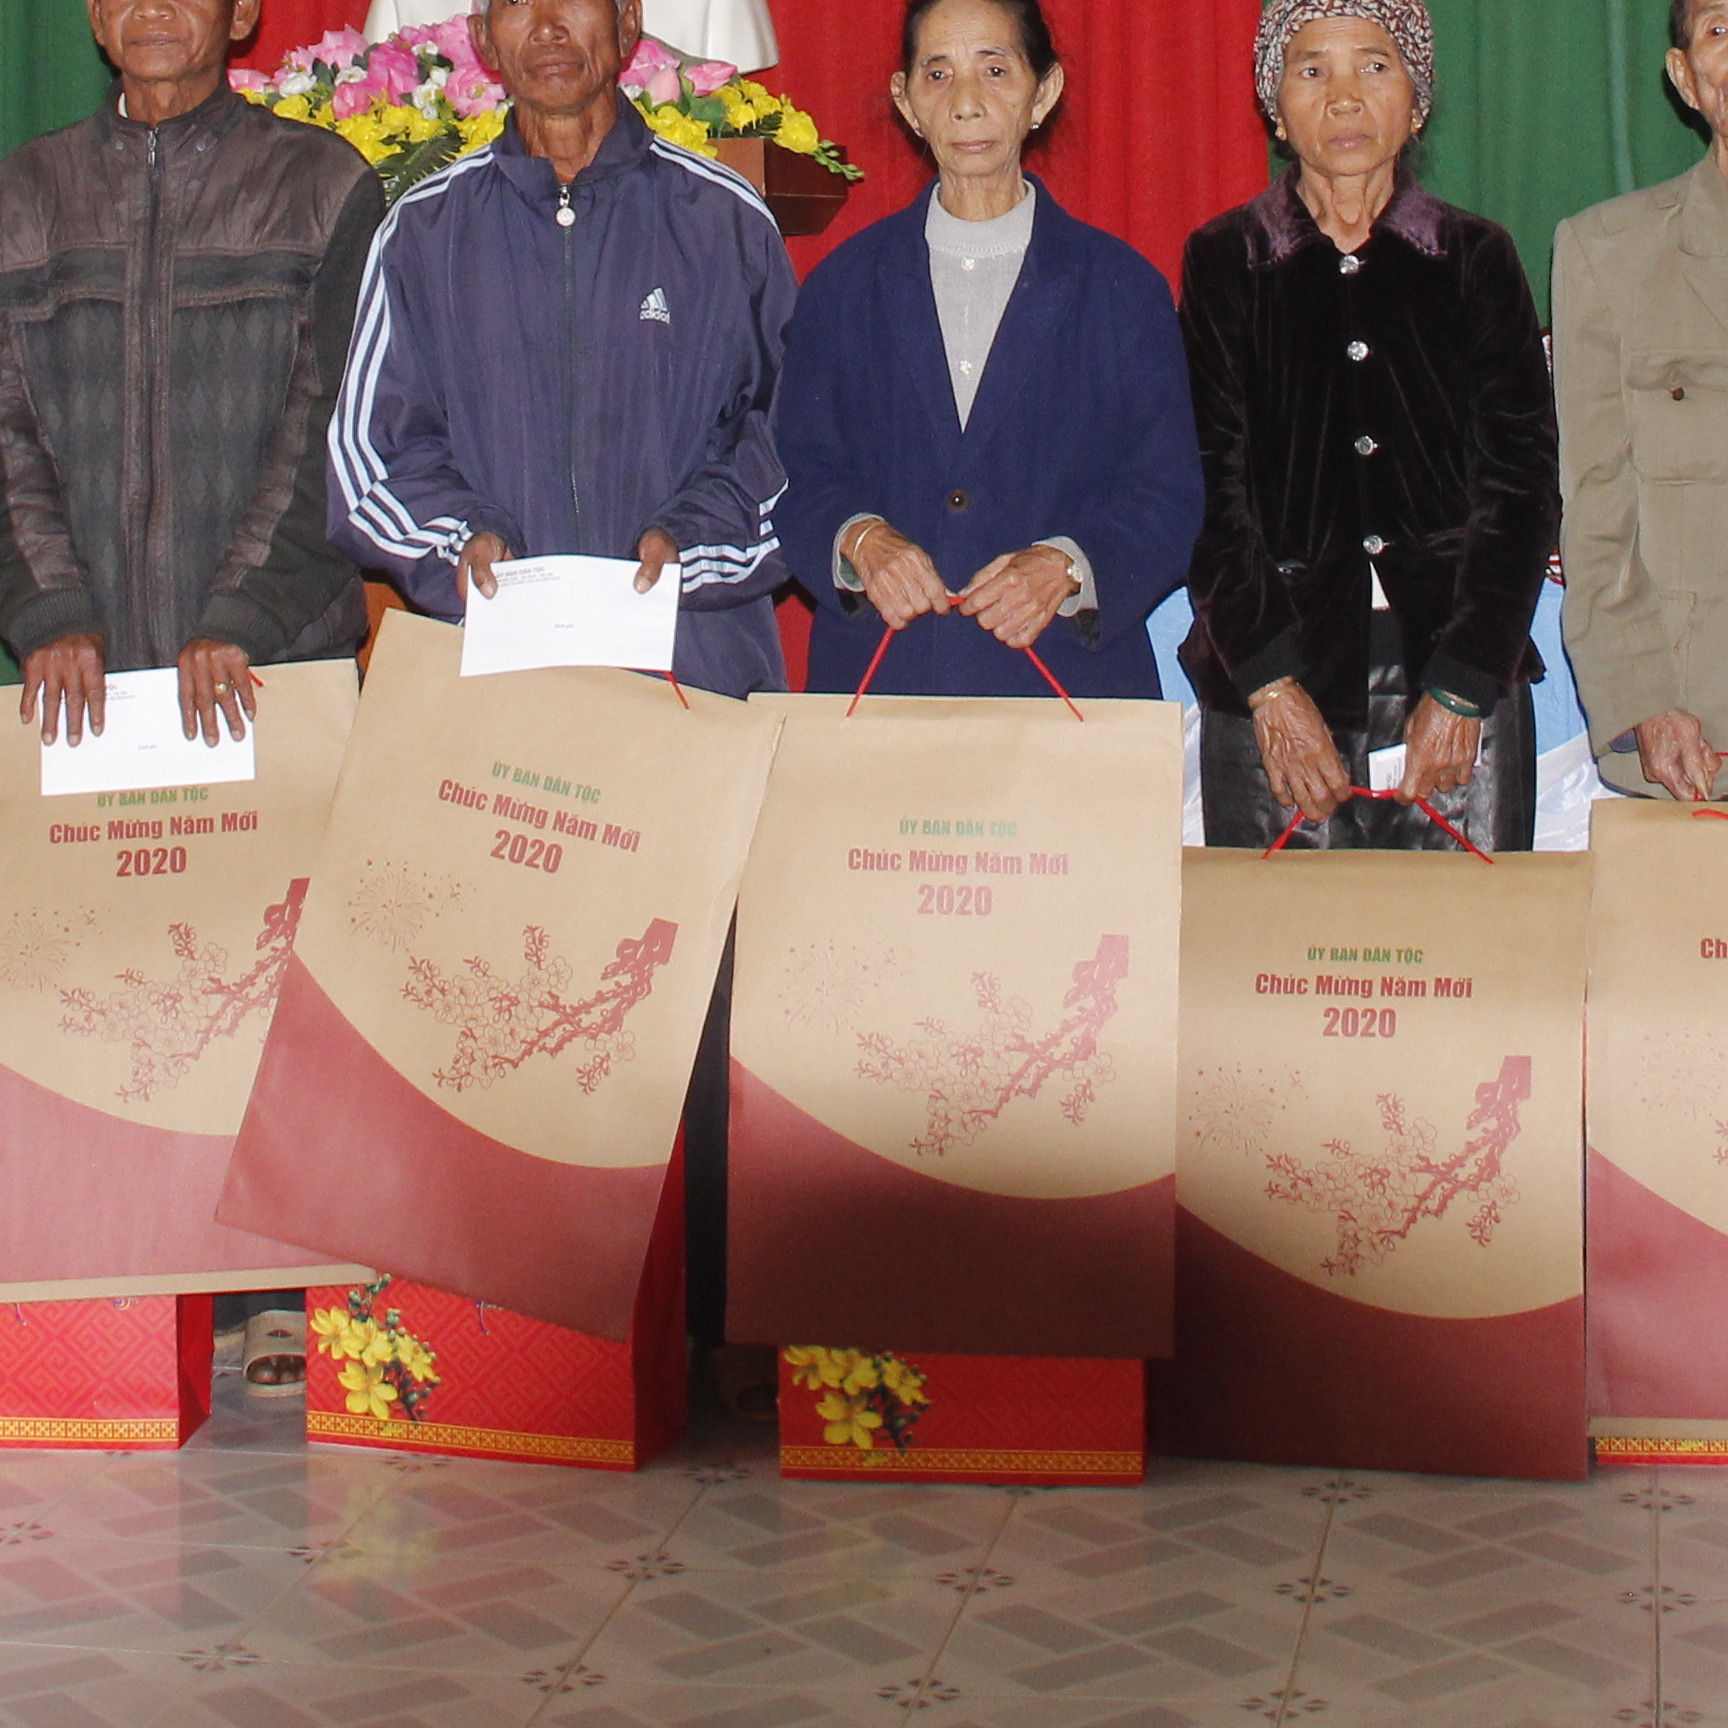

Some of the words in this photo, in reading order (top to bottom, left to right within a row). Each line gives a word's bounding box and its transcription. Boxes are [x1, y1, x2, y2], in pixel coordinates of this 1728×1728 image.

[50, 822, 102, 843] Chúc
[108, 819, 163, 839] Mừng
[171, 816, 215, 834] Năm
[222, 811, 259, 831] Mới
[439, 779, 489, 810] Chúc
[493, 794, 549, 828] Mừng
[553, 811, 598, 840] Năm
[602, 824, 641, 851] Mới
[118, 846, 187, 876] 2020
[492, 832, 563, 873] 2020
[918, 884, 992, 915] 2020
[1256, 973, 1308, 994] Chúc
[1315, 975, 1374, 998] Mừng
[1380, 976, 1428, 997] Năm
[1434, 977, 1472, 997] Mới
[1323, 1008, 1397, 1038] 2020
